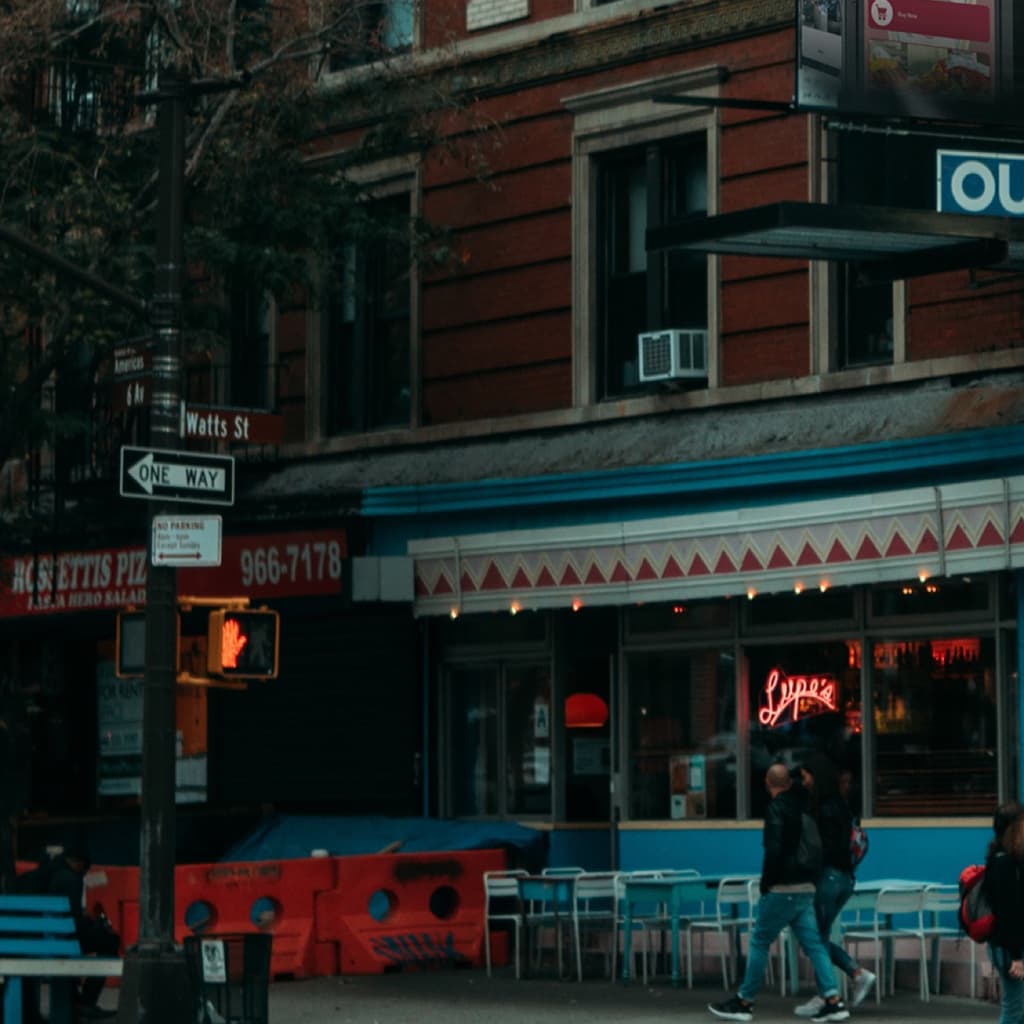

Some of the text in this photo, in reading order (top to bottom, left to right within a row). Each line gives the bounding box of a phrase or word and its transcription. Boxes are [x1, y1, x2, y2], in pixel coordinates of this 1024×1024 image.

[114, 355, 144, 373] Americas
[126, 383, 144, 406] 6 Av
[186, 412, 250, 439] Watts St
[139, 464, 219, 489] ONE WAY
[157, 522, 168, 530] NO
[241, 540, 342, 588] 966-7178
[69, 591, 102, 609] HERO
[758, 670, 835, 726] Lupe's
